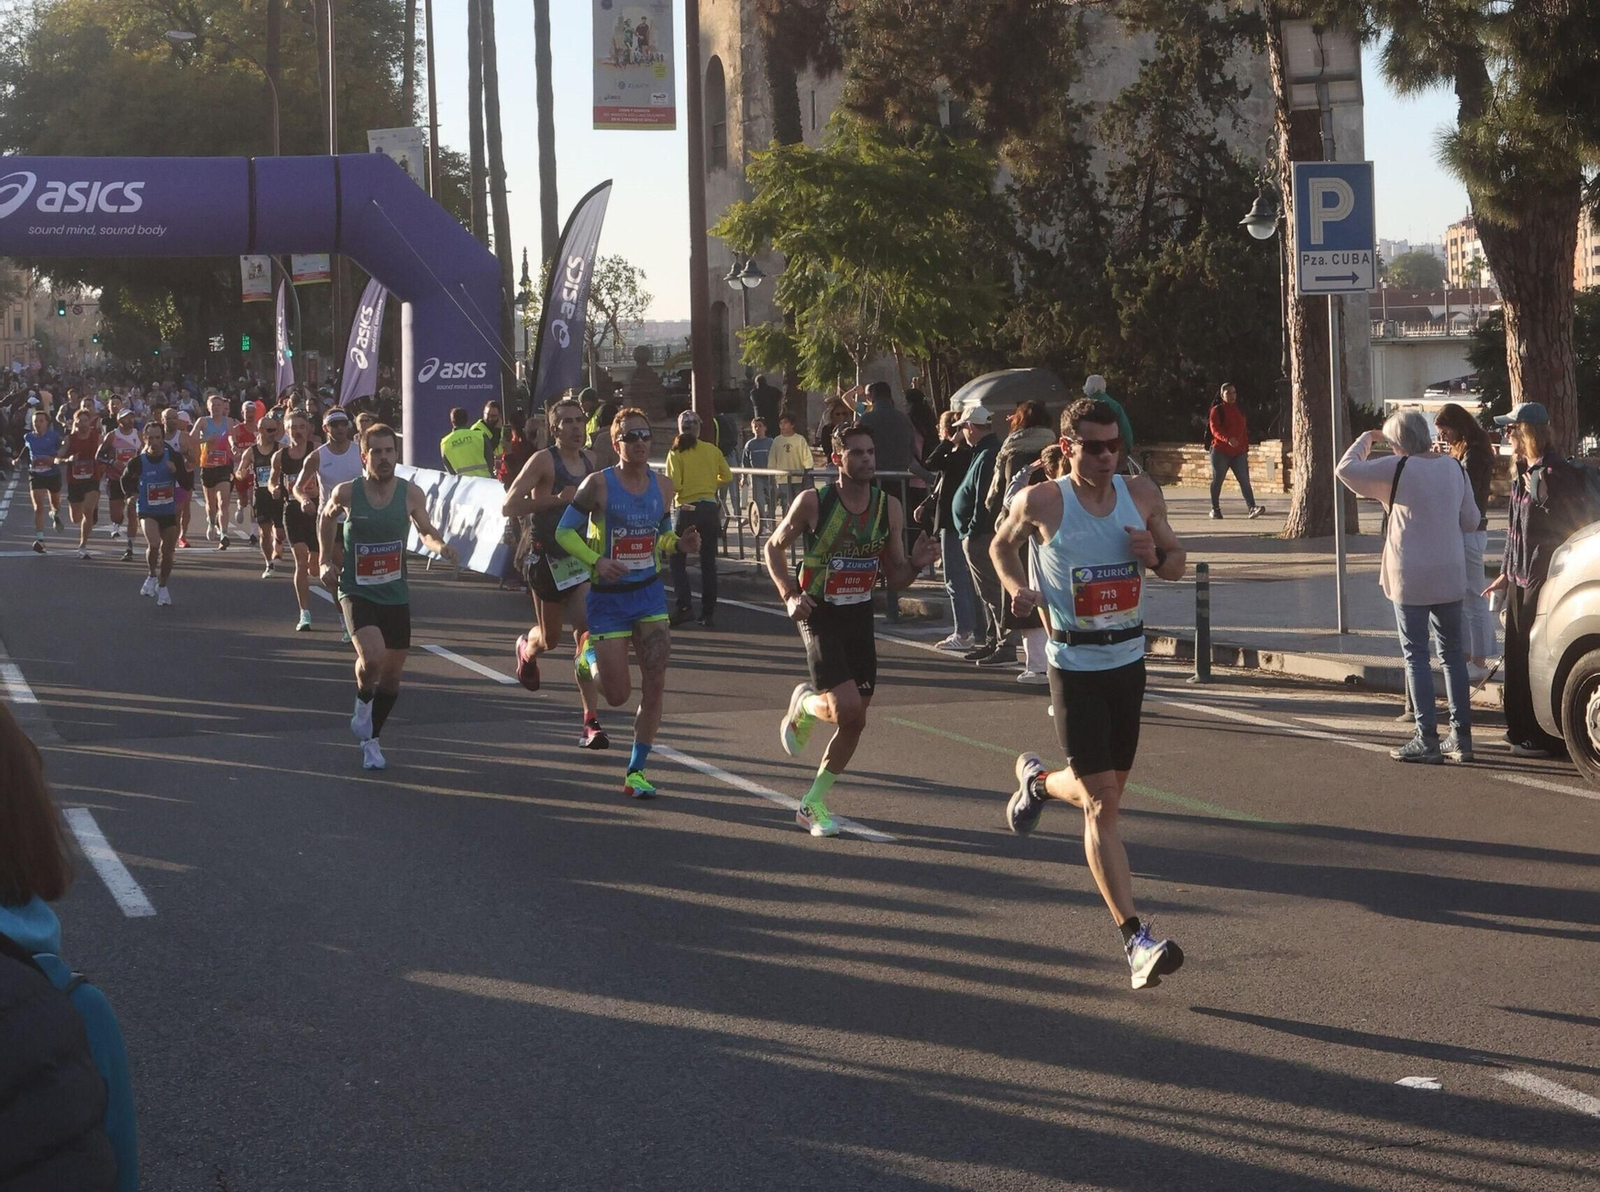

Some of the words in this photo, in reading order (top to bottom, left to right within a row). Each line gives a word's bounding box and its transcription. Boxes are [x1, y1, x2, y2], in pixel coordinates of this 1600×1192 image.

[36, 180, 146, 213] asics
[1308, 176, 1355, 245] P
[28, 224, 65, 236] sound
[66, 224, 97, 237] mind,
[99, 224, 136, 236] sound
[137, 224, 167, 238] body
[1302, 254, 1328, 266] Pza.
[1332, 252, 1370, 265] CUBA
[440, 362, 487, 379] asics
[846, 561, 873, 569] ZURICH
[1096, 568, 1132, 578] ZURICH
[1100, 589, 1117, 600] 713
[1099, 603, 1118, 612] LOLA
